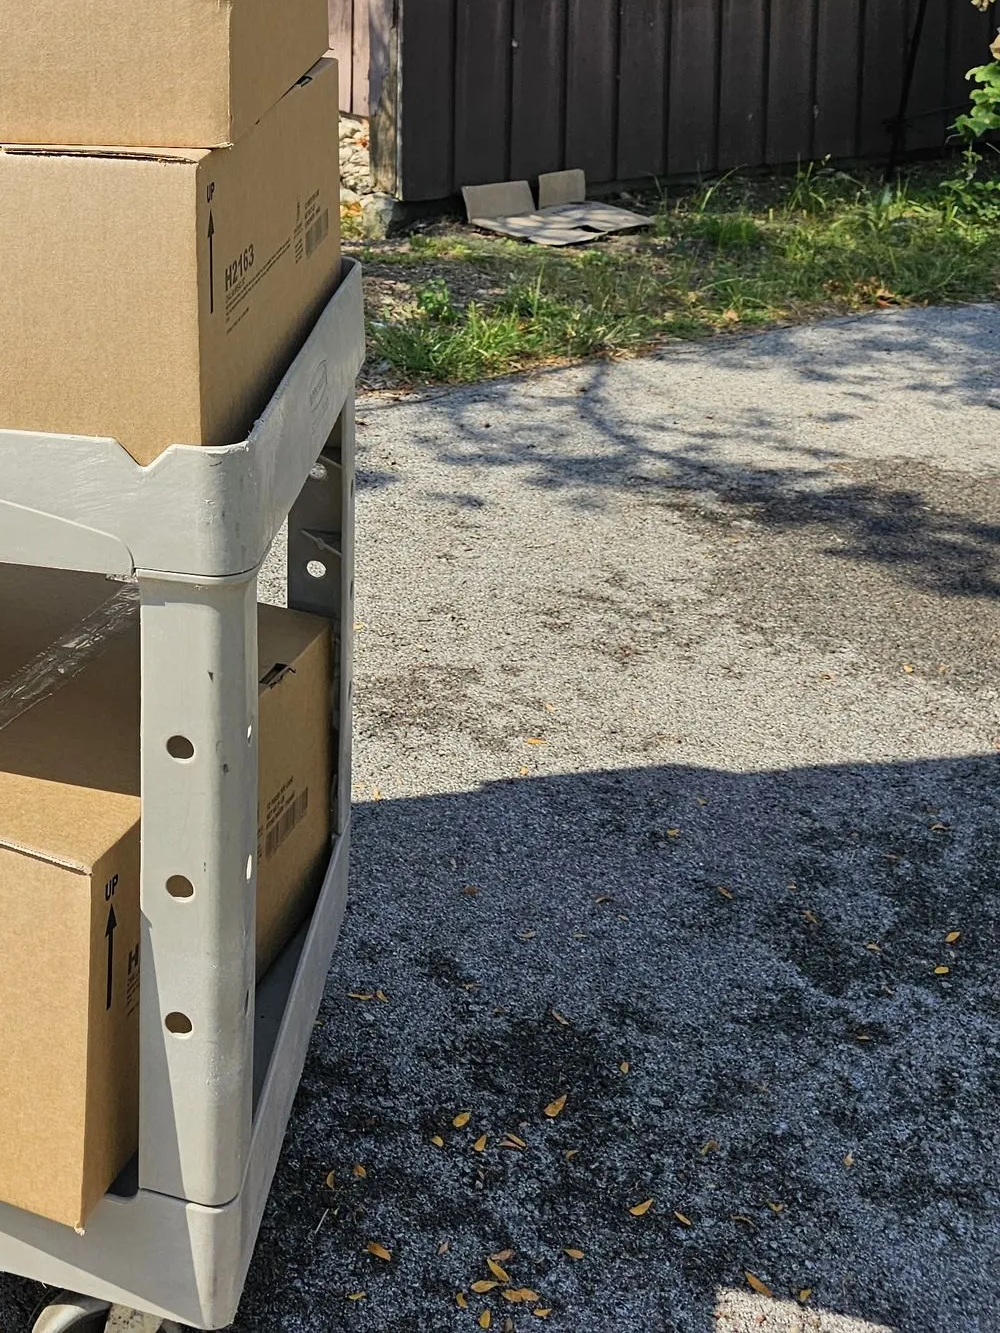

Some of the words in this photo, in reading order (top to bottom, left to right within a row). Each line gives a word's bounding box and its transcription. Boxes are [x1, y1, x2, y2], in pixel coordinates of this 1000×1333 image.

[206, 181, 215, 203] UP
[224, 243, 255, 292] H2163
[105, 873, 119, 902] UP
